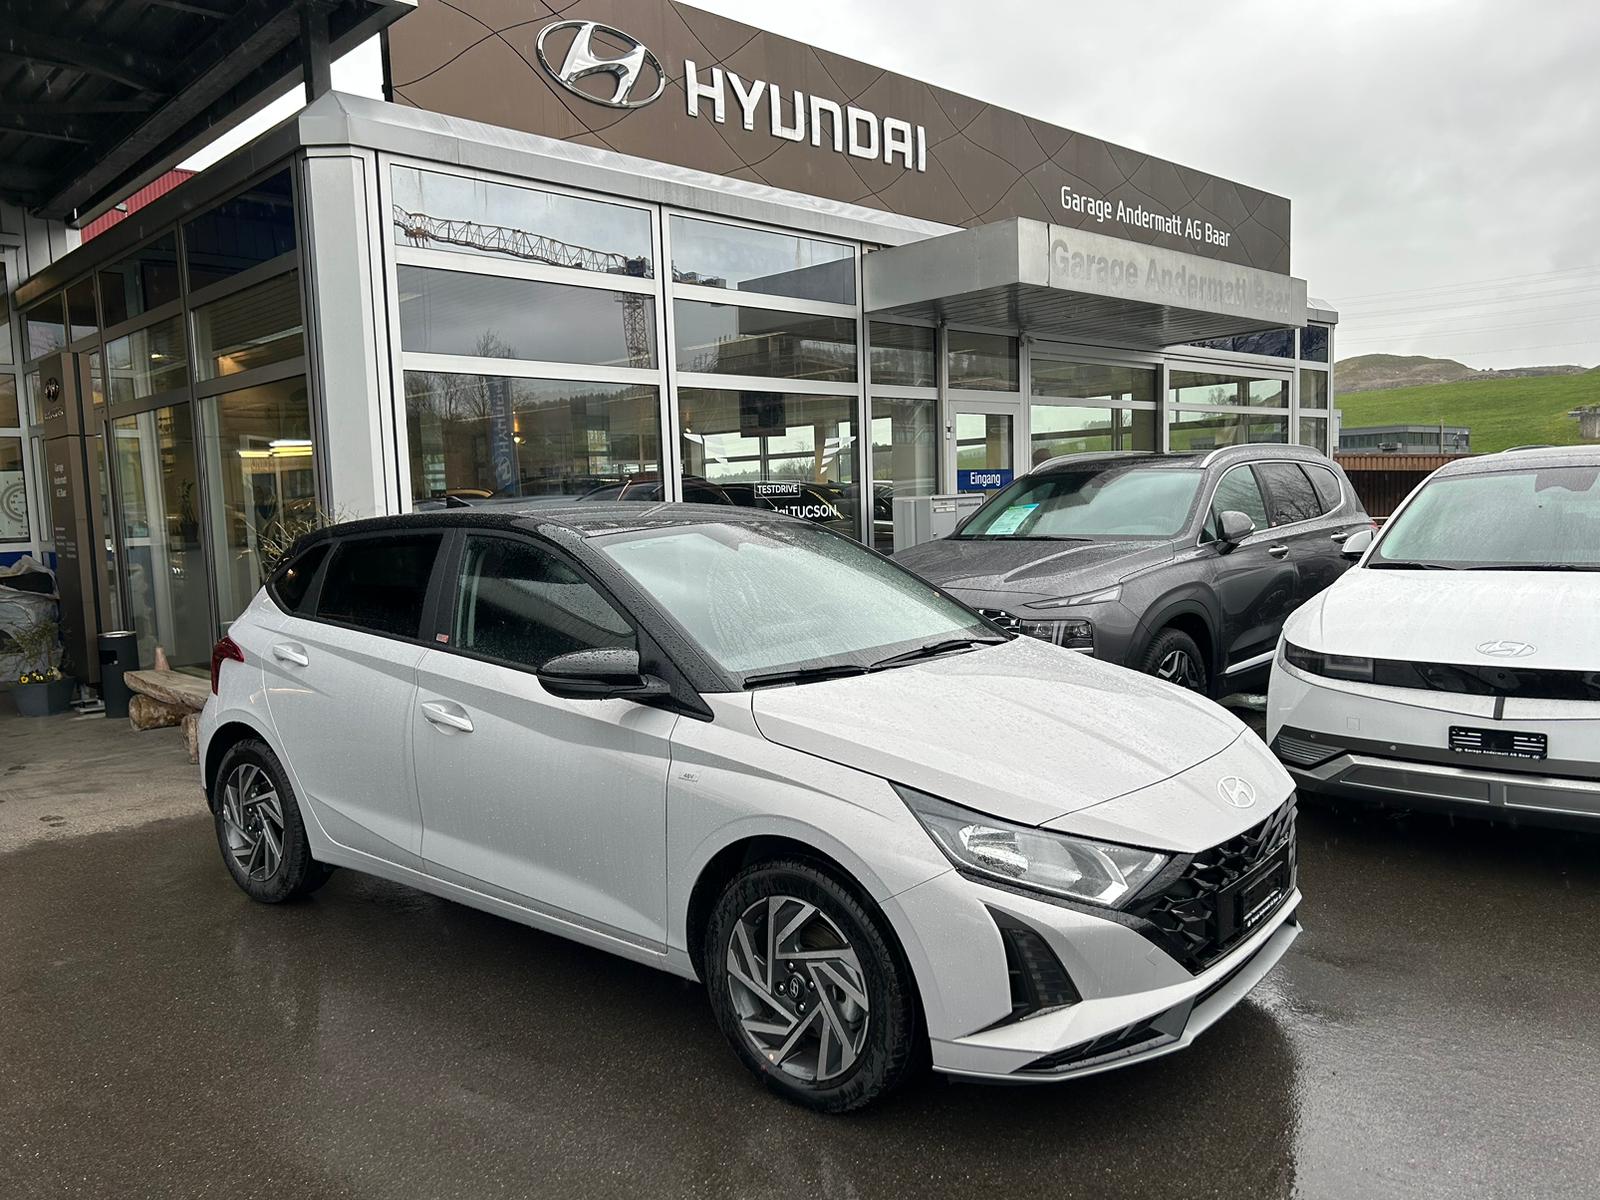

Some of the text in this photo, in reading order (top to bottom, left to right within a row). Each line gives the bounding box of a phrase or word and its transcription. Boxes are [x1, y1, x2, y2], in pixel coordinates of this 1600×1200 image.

[684, 59, 927, 172] HYUNDAI
[1061, 186, 1231, 248] Garage Andermatt AG Baar
[1051, 239, 1139, 289] Garage
[1145, 258, 1246, 303] Andermatt
[757, 484, 798, 494] TESTDRIVE
[970, 472, 1001, 487] Eingang
[790, 504, 837, 518] TUCSON
